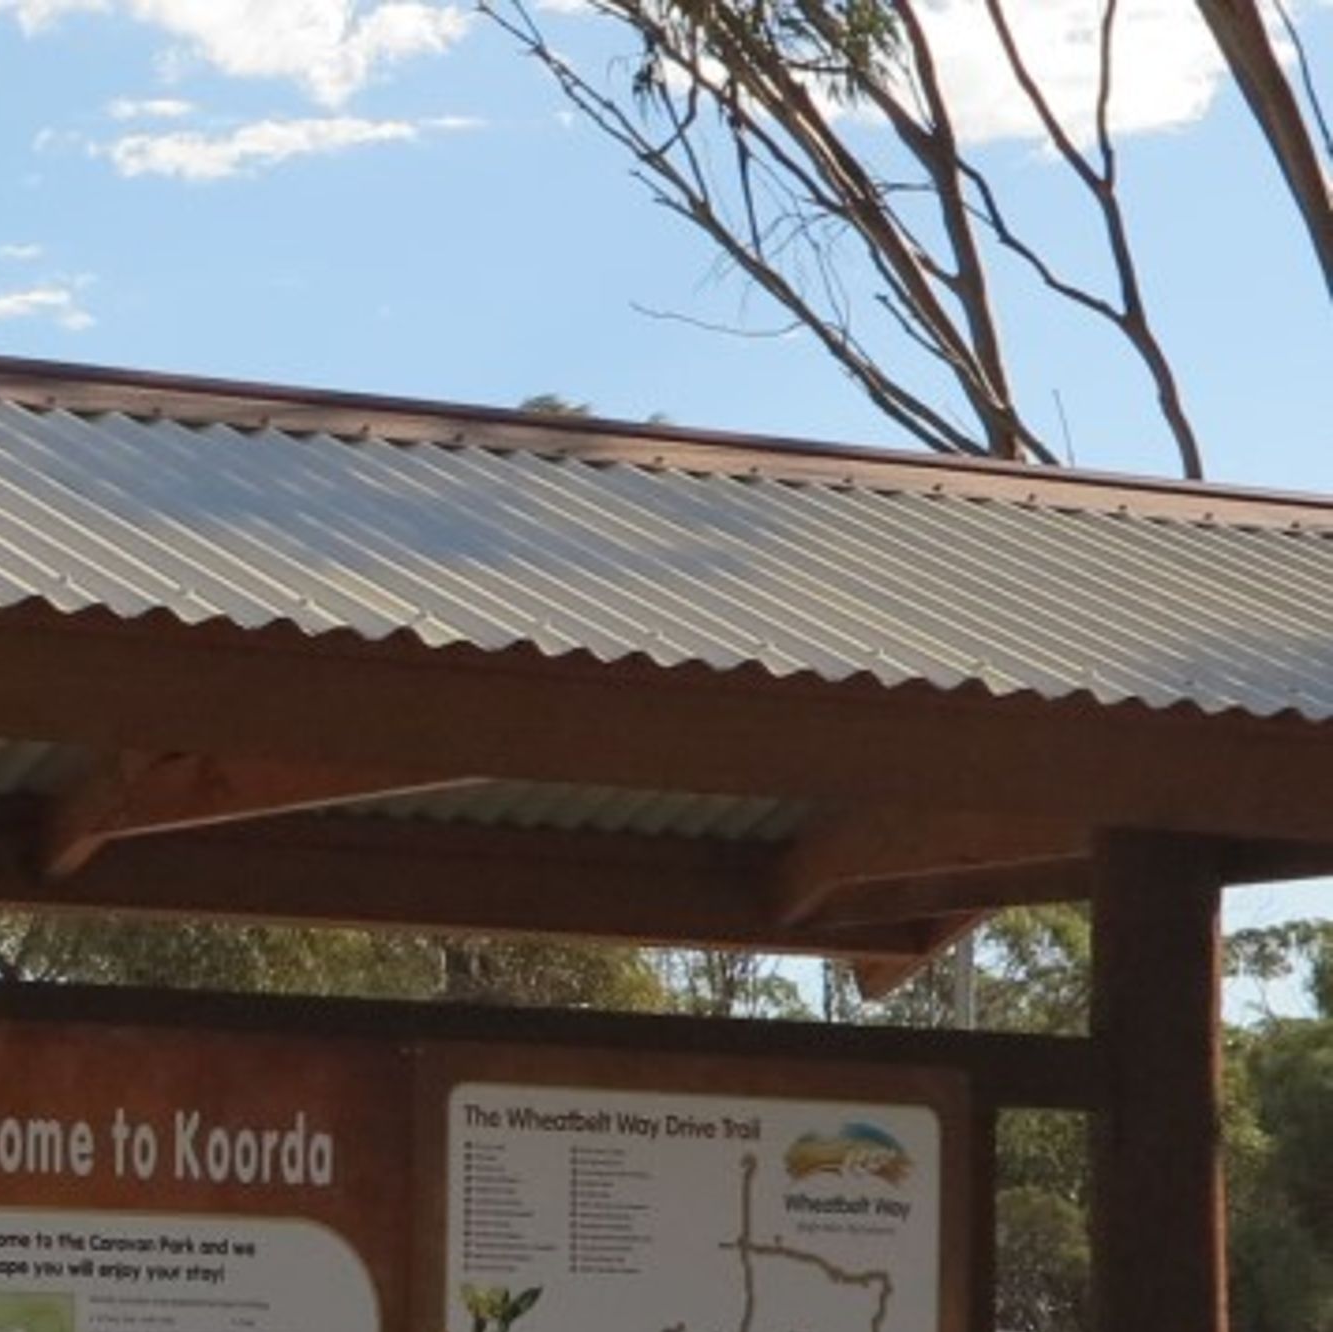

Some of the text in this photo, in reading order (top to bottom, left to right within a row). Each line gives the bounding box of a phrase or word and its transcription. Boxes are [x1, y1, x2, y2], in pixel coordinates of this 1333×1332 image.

[463, 1104, 761, 1141] The Wheatbelt Way Drive Trail
[111, 1107, 158, 1180] to
[174, 1109, 333, 1185] Koorda
[784, 1194, 912, 1223] Wheatbelt Way
[36, 1230, 53, 1249] to
[59, 1231, 84, 1251] the
[89, 1234, 155, 1252] Caravan
[160, 1235, 195, 1254] Park
[199, 1238, 229, 1256] and
[232, 1241, 256, 1257] we
[33, 1261, 64, 1278] you
[67, 1259, 95, 1277] will
[98, 1261, 141, 1281] enjoy
[146, 1264, 180, 1282] your
